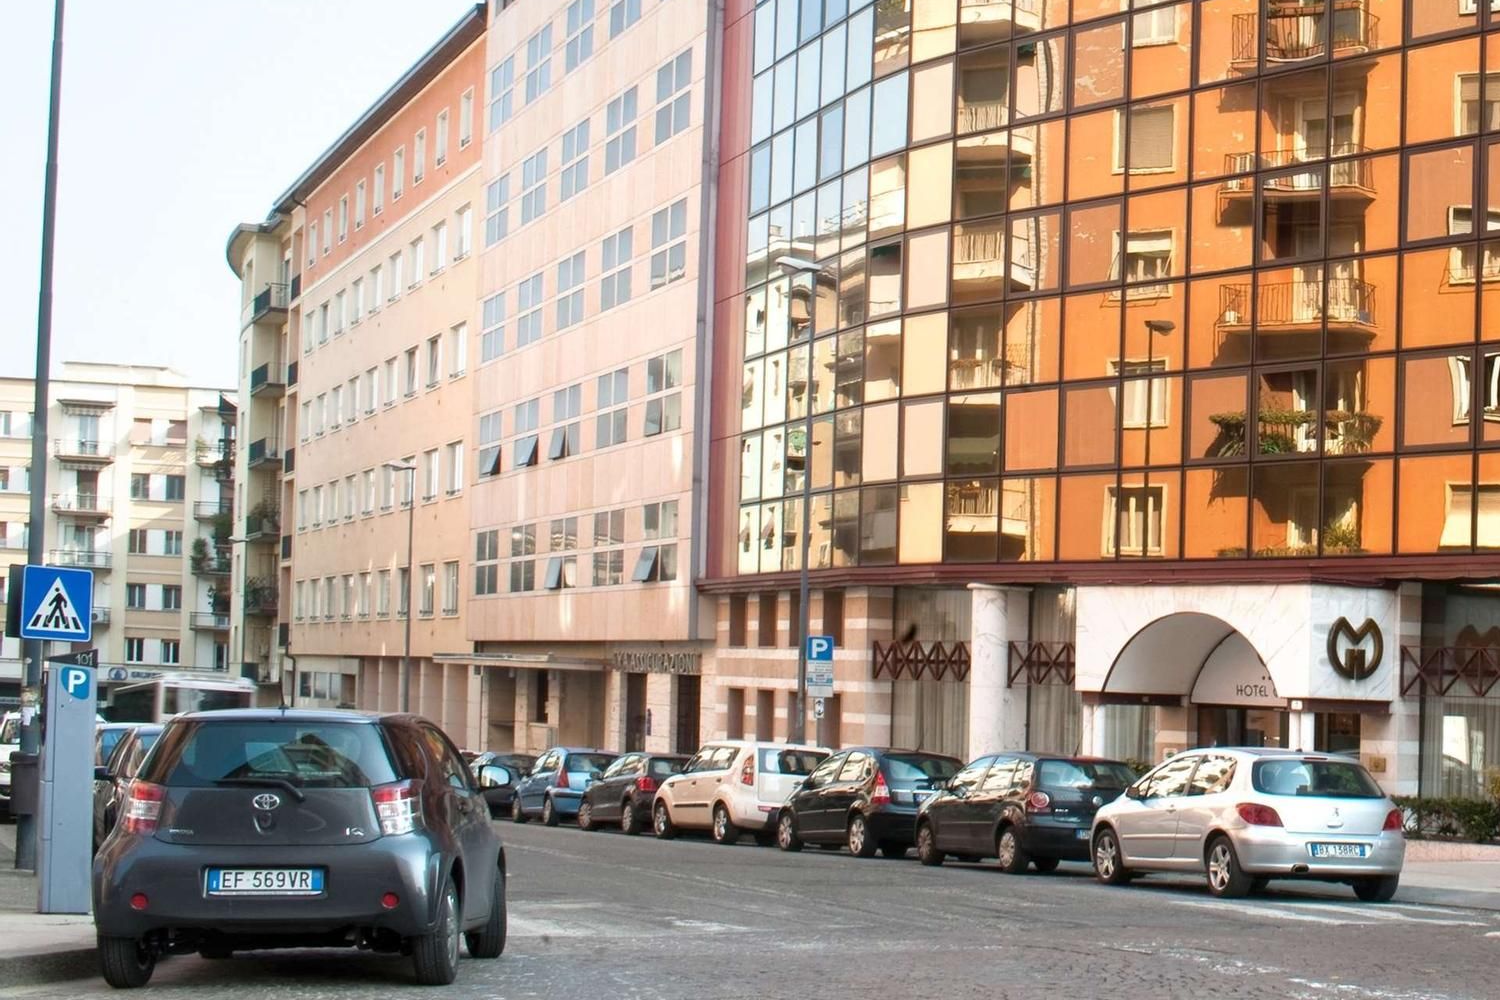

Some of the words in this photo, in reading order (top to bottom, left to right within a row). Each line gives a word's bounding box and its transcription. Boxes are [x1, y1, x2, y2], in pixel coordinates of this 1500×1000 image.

[811, 638, 829, 659] P
[75, 652, 93, 666] 101
[68, 670, 87, 694] P
[1236, 684, 1269, 697] HOTEL
[221, 871, 244, 889] EF
[252, 871, 311, 889] 569VR
